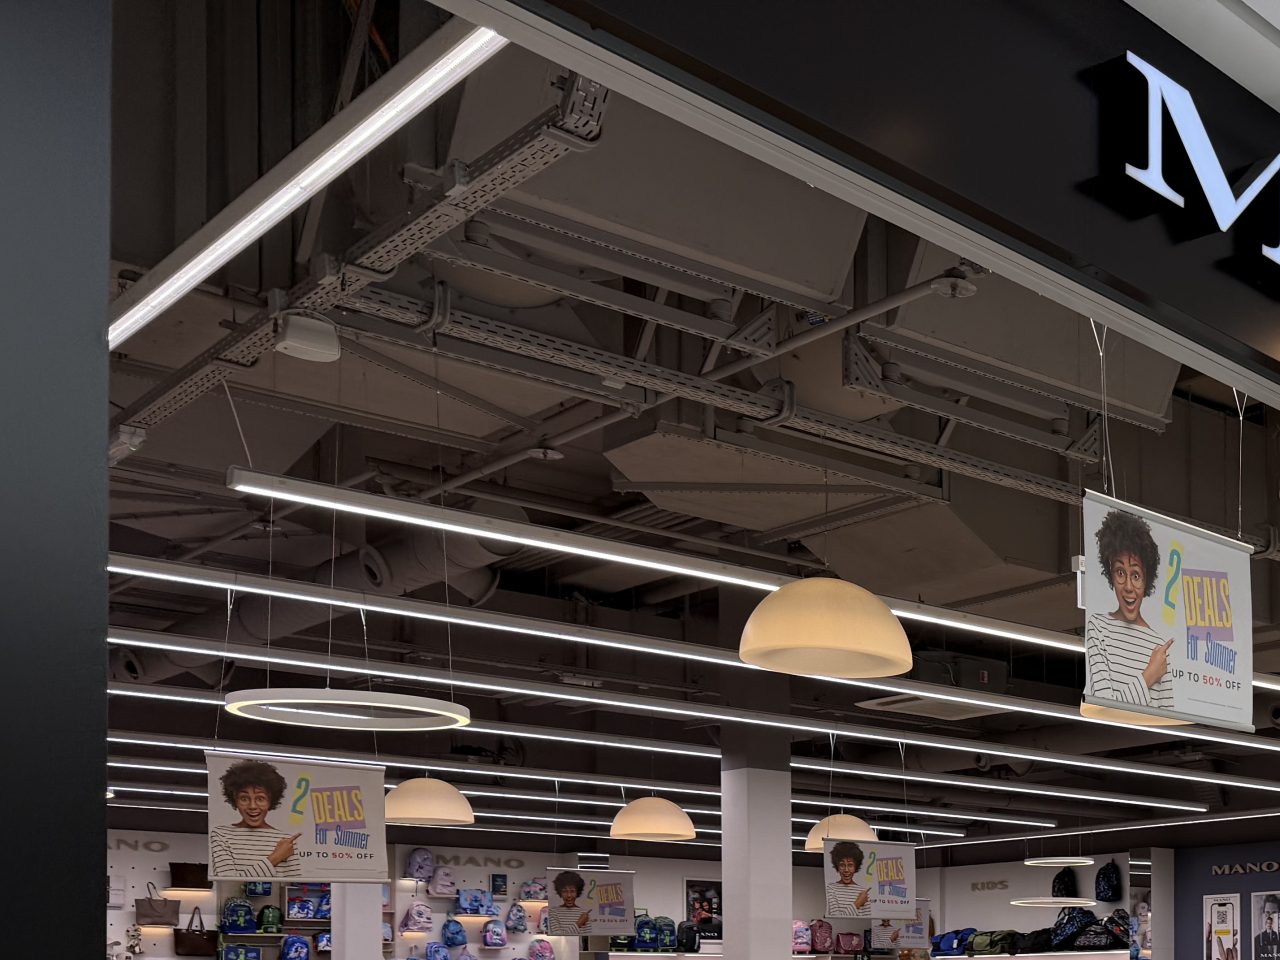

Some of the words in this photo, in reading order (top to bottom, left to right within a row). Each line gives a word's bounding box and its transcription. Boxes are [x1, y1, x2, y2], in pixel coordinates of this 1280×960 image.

[1164, 548, 1181, 609] 2
[1183, 575, 1232, 628] DEALS
[1204, 632, 1238, 675] Summer
[1172, 670, 1184, 679] UP
[1187, 672, 1200, 682] TO
[1202, 674, 1222, 687] 50%
[1226, 678, 1242, 692] OFF
[291, 777, 310, 815] 2
[311, 790, 365, 824] DEALS
[335, 824, 370, 849] Summer
[436, 854, 525, 869] MANO
[877, 859, 904, 880] DEALS
[1212, 862, 1280, 876] MANO
[971, 880, 1008, 891] KIDS
